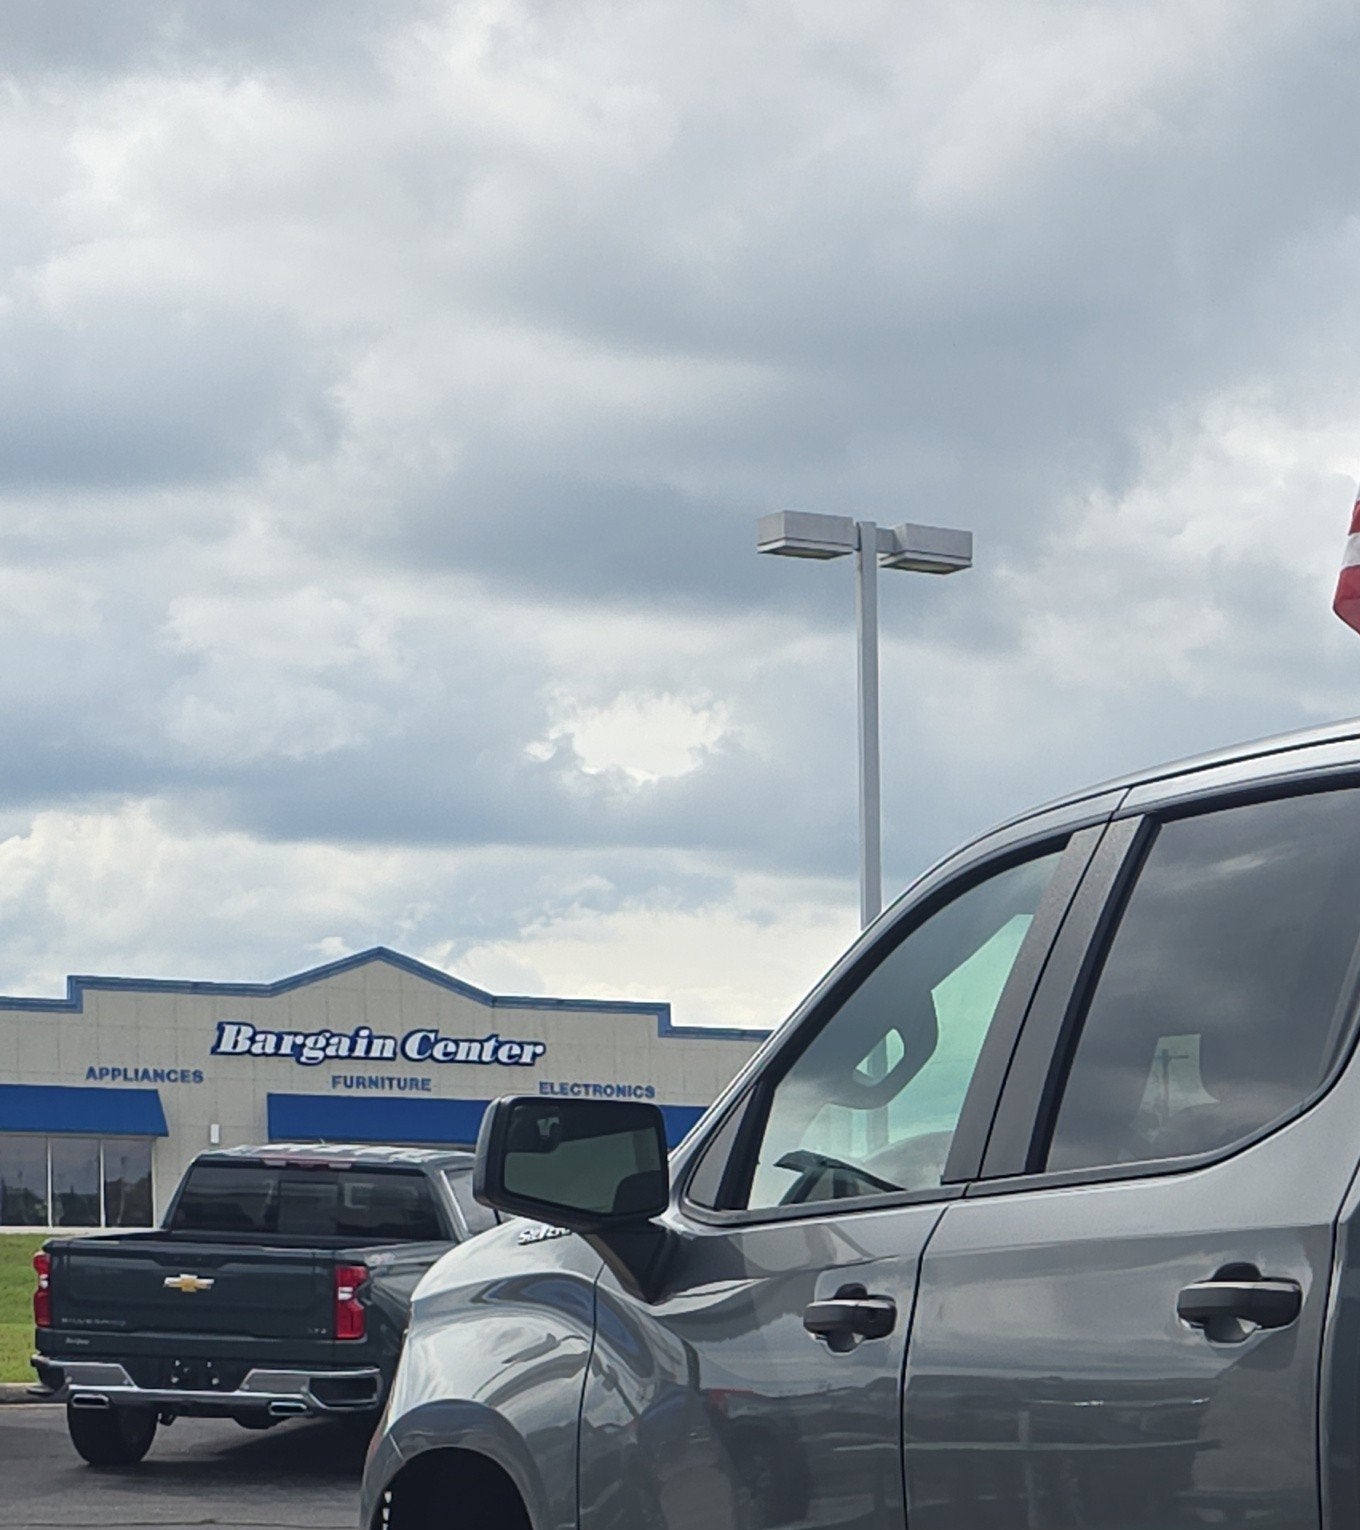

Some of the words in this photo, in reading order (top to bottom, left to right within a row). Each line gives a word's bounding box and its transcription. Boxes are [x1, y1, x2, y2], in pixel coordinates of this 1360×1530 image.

[210, 1021, 397, 1066] Bargain
[401, 1029, 546, 1066] Center
[85, 1066, 204, 1084] APPLIANCES
[331, 1075, 432, 1092] FURNITURE
[539, 1081, 656, 1099] ELECTRONICS
